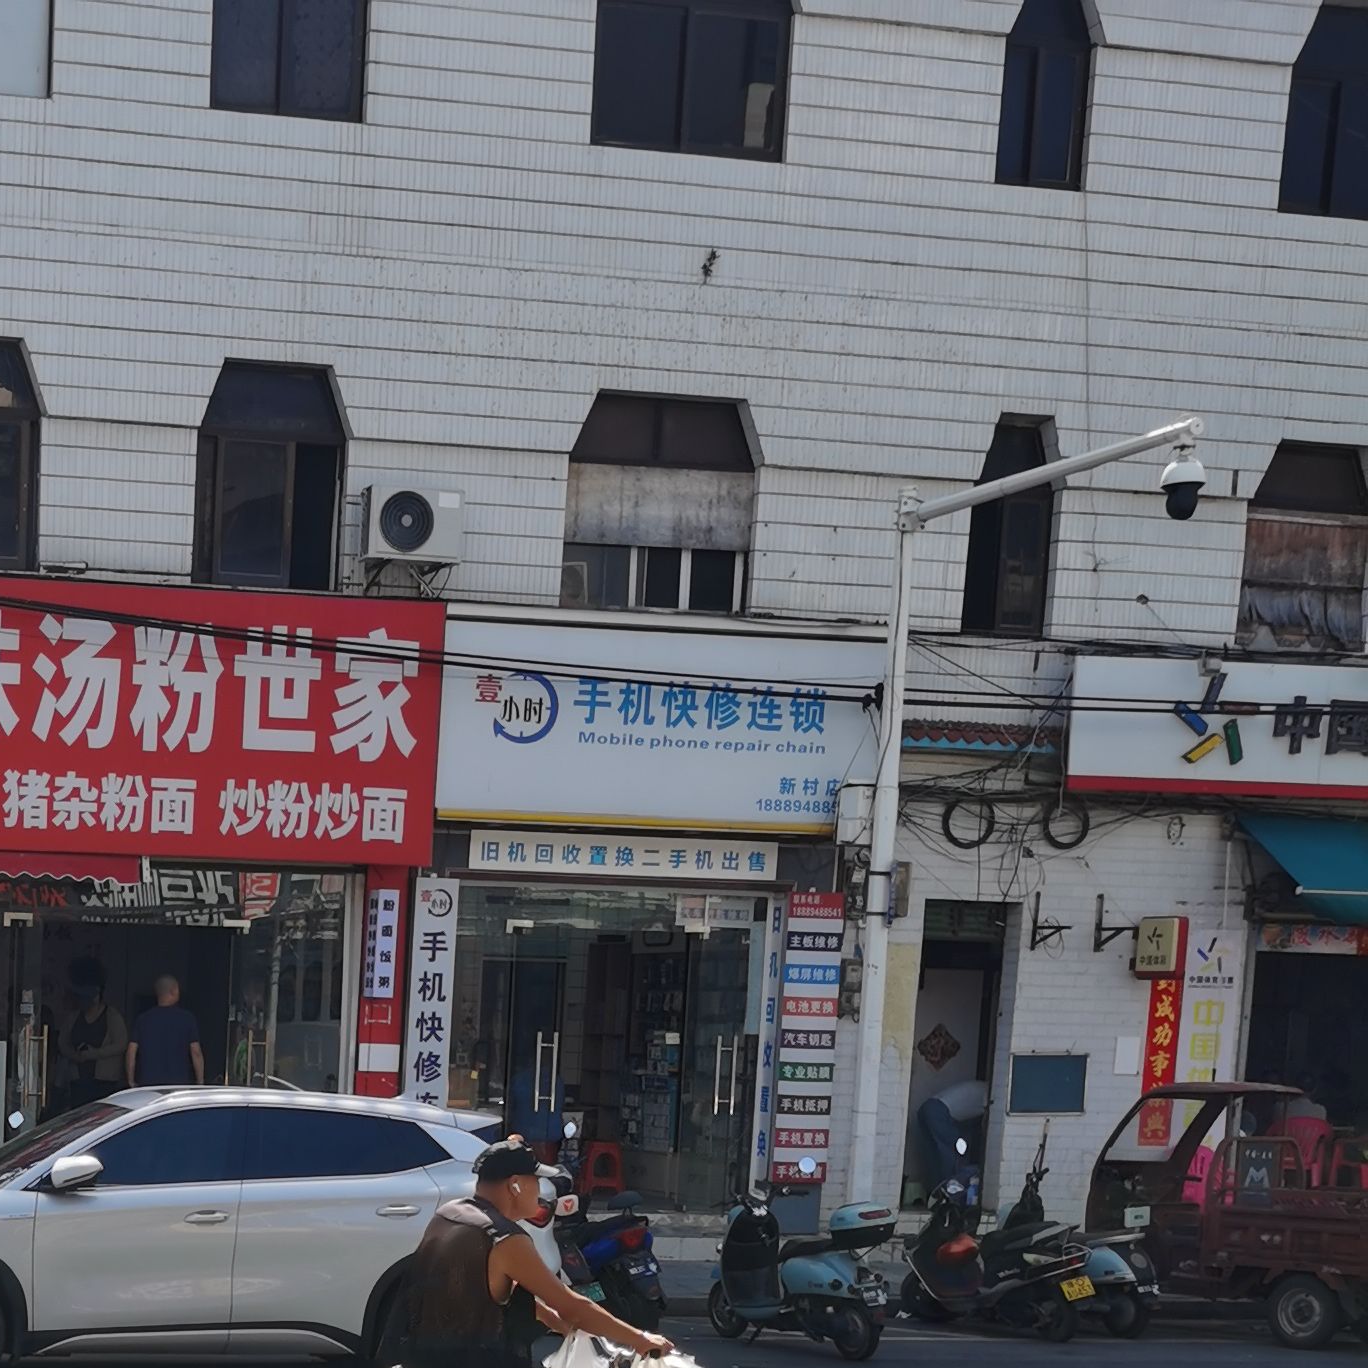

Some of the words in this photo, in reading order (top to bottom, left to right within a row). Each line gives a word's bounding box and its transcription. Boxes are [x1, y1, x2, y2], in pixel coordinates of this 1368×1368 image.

[573, 674, 828, 735] 手机快修连锁
[578, 731, 644, 748] Mobile
[649, 737, 709, 752] phone
[714, 741, 771, 754] repair
[775, 740, 826, 755] chain
[778, 776, 840, 797] 新村店
[2, 769, 196, 834] 猪杂粉面
[219, 778, 408, 843] 炒粉炒面
[480, 840, 767, 873] 旧机回收置换二手机出售
[790, 935, 839, 949] 主板维修
[788, 967, 837, 981] 爆屏维修
[786, 1000, 834, 1014] 电池更换
[783, 1032, 832, 1047] 汽车钥匙
[781, 1065, 831, 1079] 专业贴膜
[780, 1098, 829, 1112] 手机抵押
[778, 1131, 826, 1145] 手机置换
